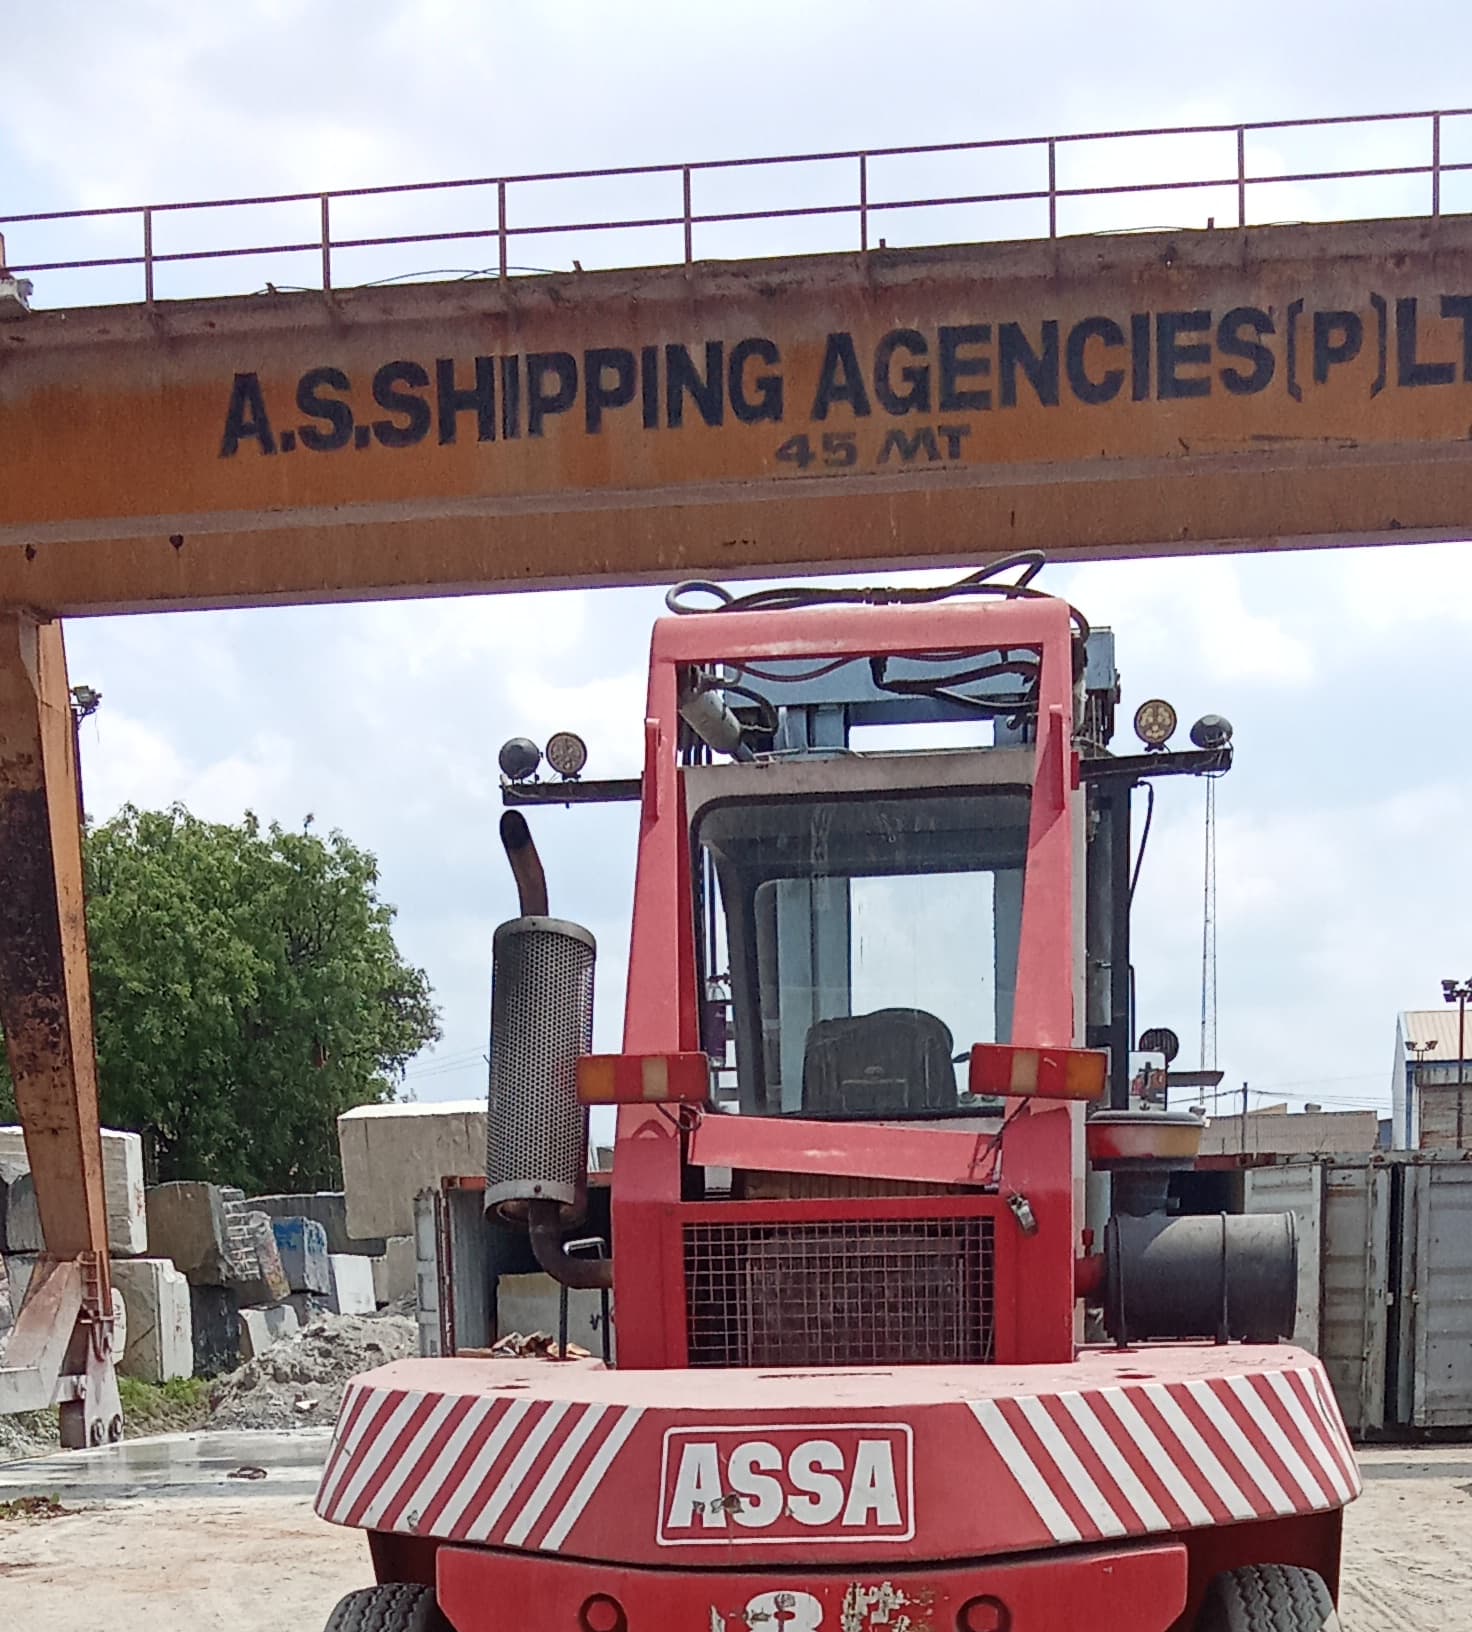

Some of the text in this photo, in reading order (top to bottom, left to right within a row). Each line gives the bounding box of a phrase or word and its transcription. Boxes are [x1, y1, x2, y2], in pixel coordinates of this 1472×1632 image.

[775, 423, 971, 470] 45 MT
[667, 1440, 902, 1528] ASSA
